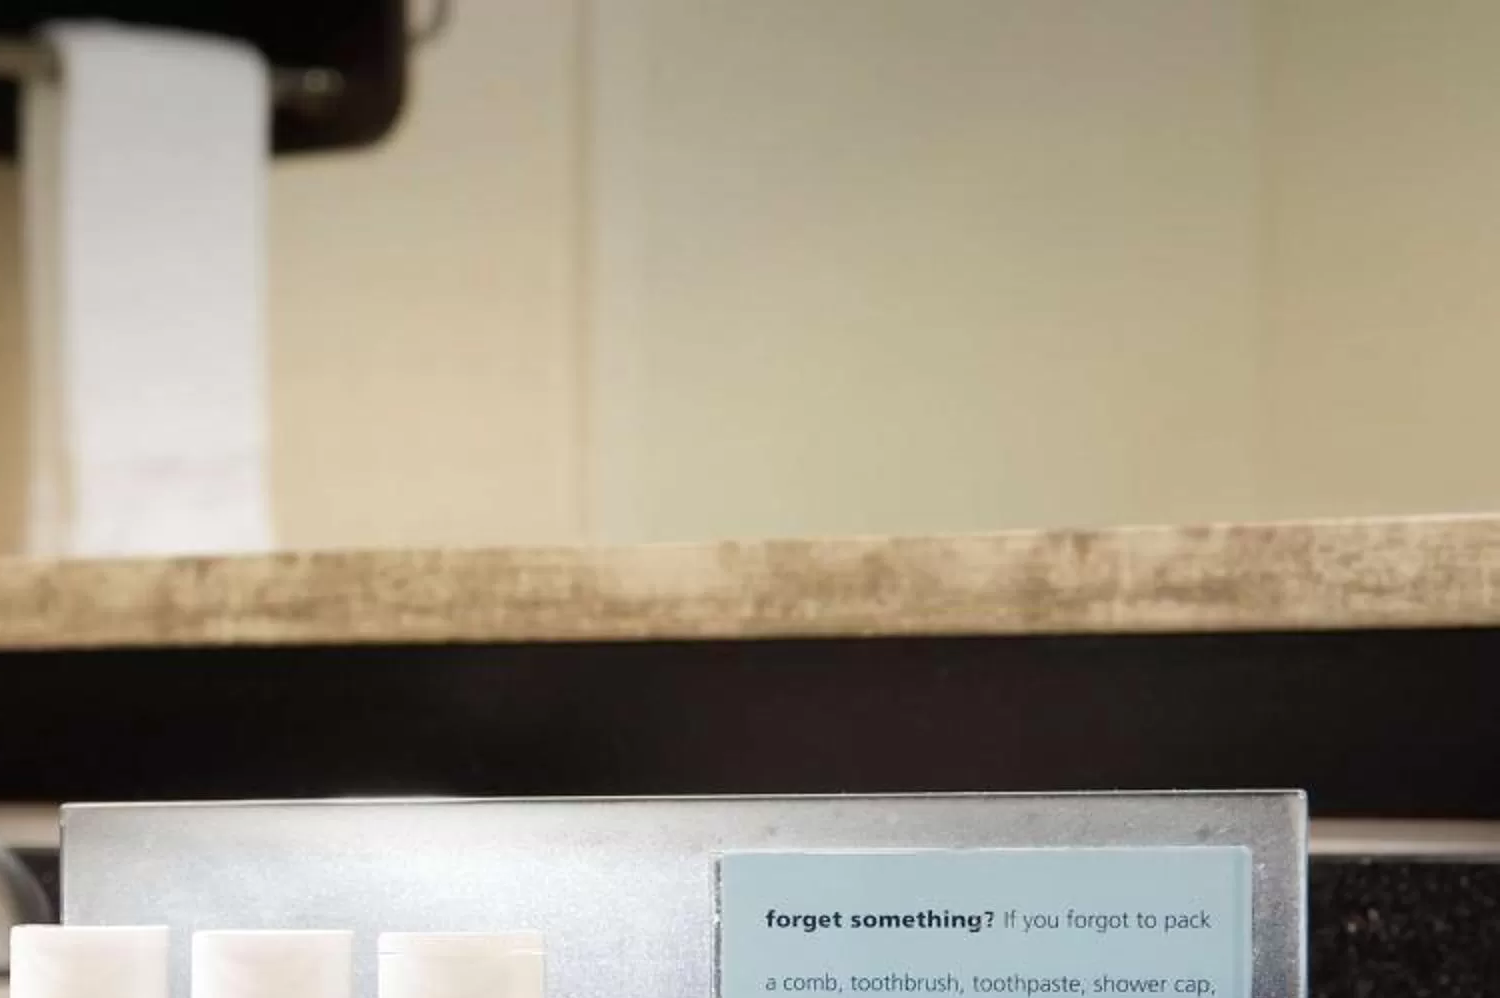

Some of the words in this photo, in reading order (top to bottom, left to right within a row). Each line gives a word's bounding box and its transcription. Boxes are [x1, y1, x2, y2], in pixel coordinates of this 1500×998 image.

[765, 909, 843, 933] forget
[851, 909, 995, 933] something?
[1003, 910, 1017, 929] If
[1022, 912, 1059, 933] you
[1067, 908, 1129, 933] forgot
[1136, 911, 1157, 929] to
[1164, 910, 1212, 933] pack
[765, 977, 777, 992] a
[783, 973, 843, 994] comb,
[851, 973, 964, 995] toothbrush,
[973, 974, 1086, 998] toothpaste,
[1093, 974, 1167, 993] shower
[1174, 978, 1216, 997] cap,
